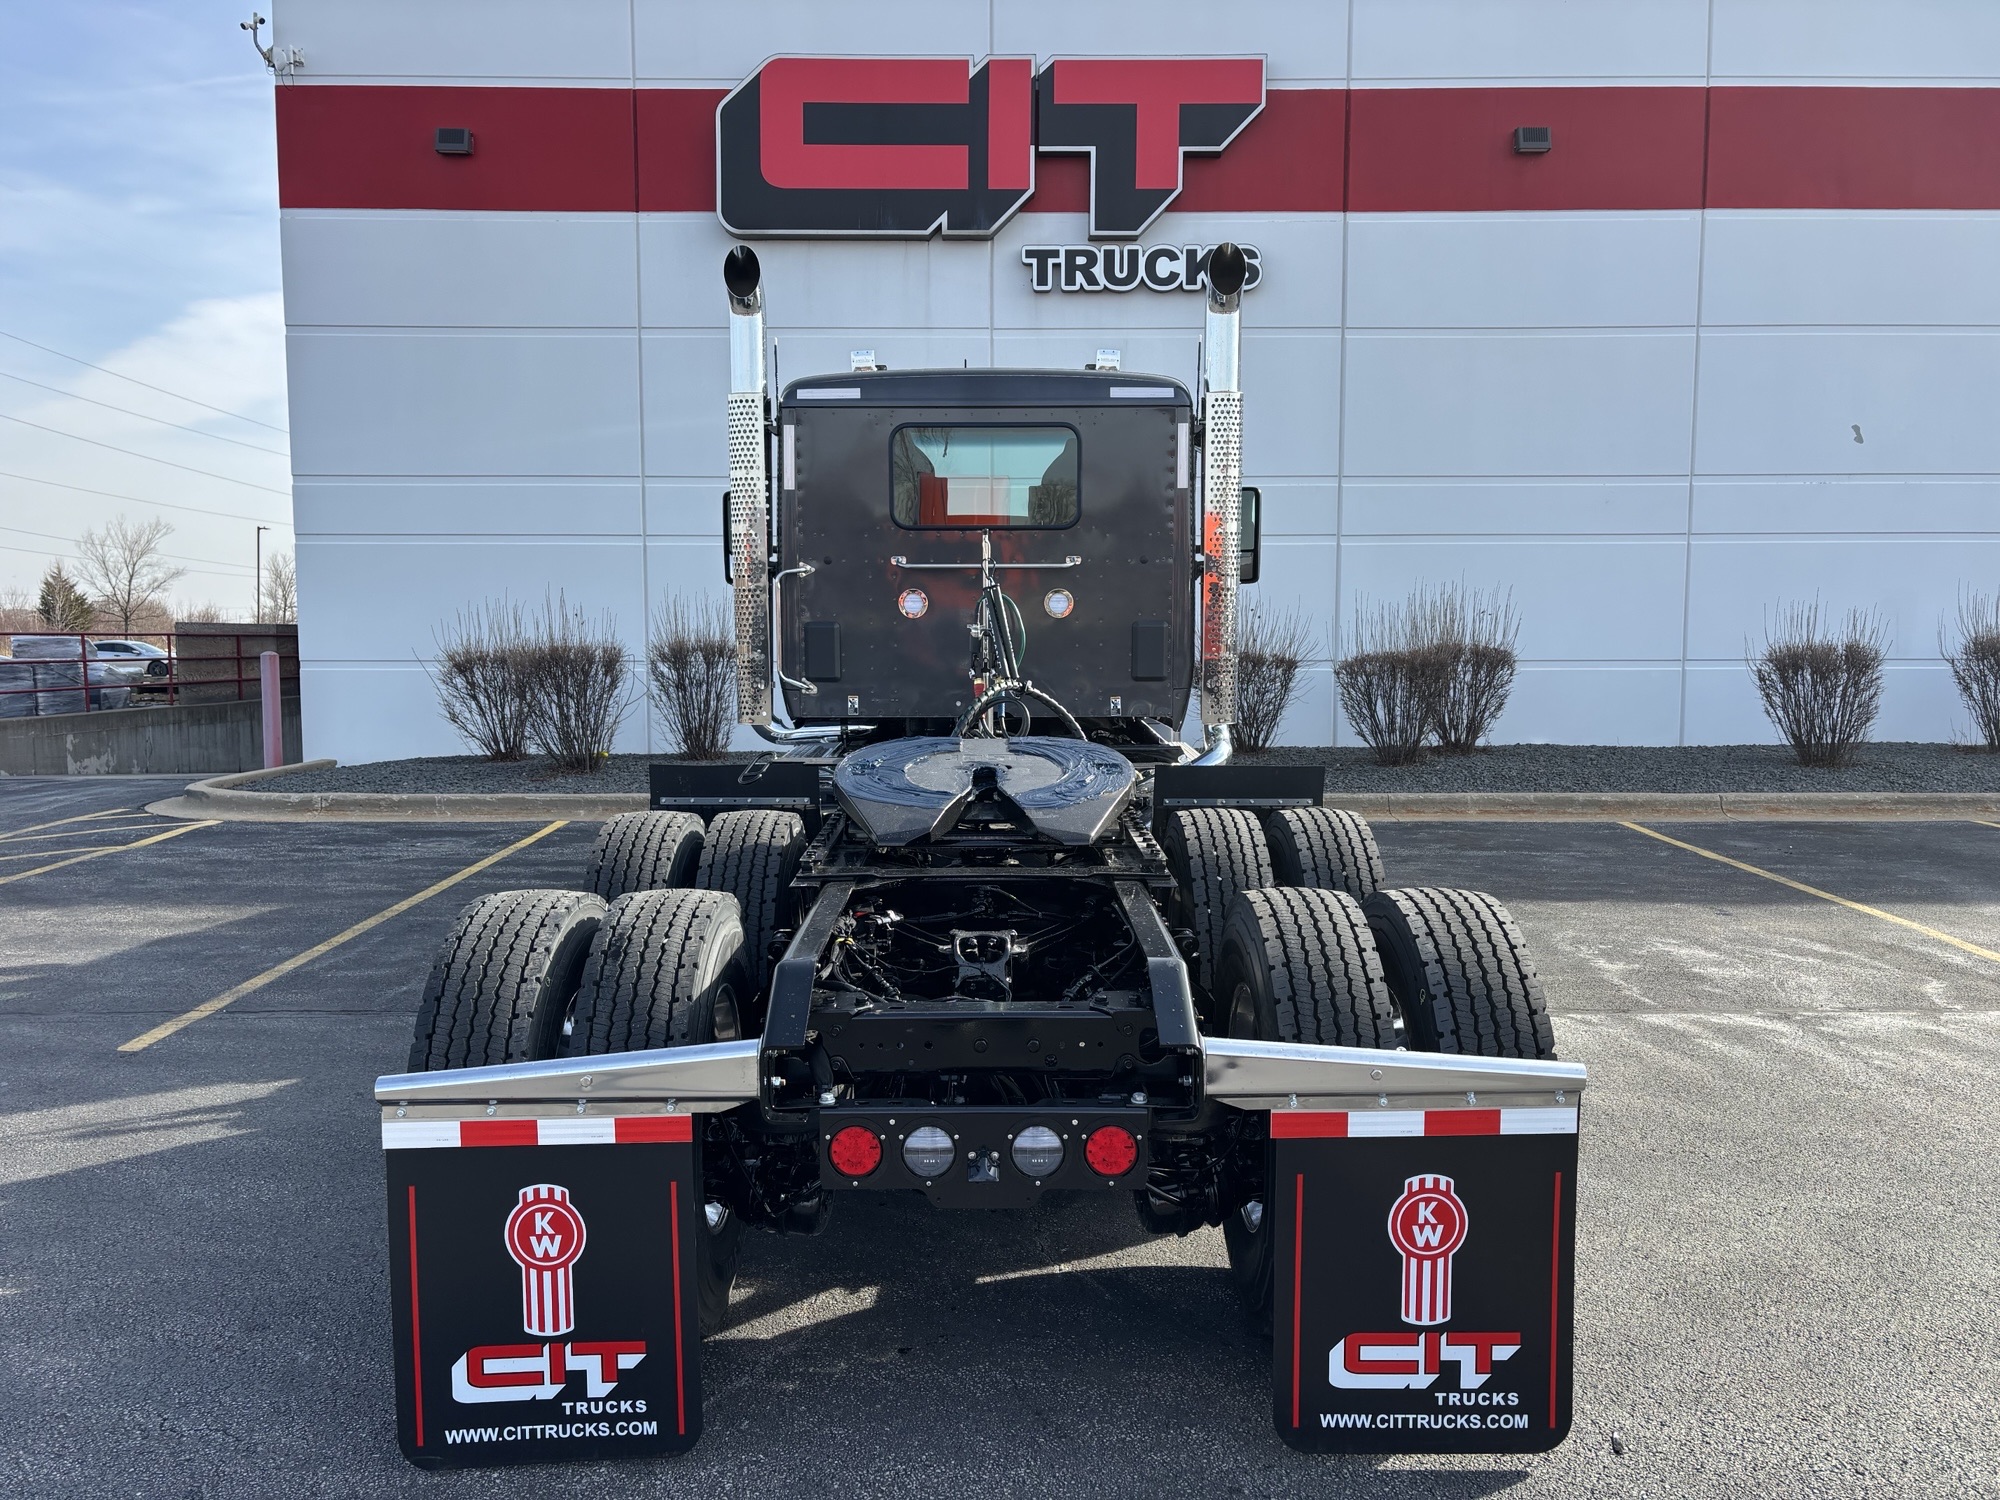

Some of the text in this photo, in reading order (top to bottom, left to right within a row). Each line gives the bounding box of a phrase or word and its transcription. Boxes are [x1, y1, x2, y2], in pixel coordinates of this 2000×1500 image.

[716, 54, 1267, 239] CIT
[452, 1341, 647, 1403] CIT
[1329, 1332, 1521, 1389] CIT
[562, 1399, 647, 1415] TRUCKS
[1435, 1392, 1519, 1406] TRUCKS
[445, 1421, 658, 1444] WWW.CITTRUCKS.COM
[1320, 1413, 1529, 1429] WWW.CITTRUCKS.COM
